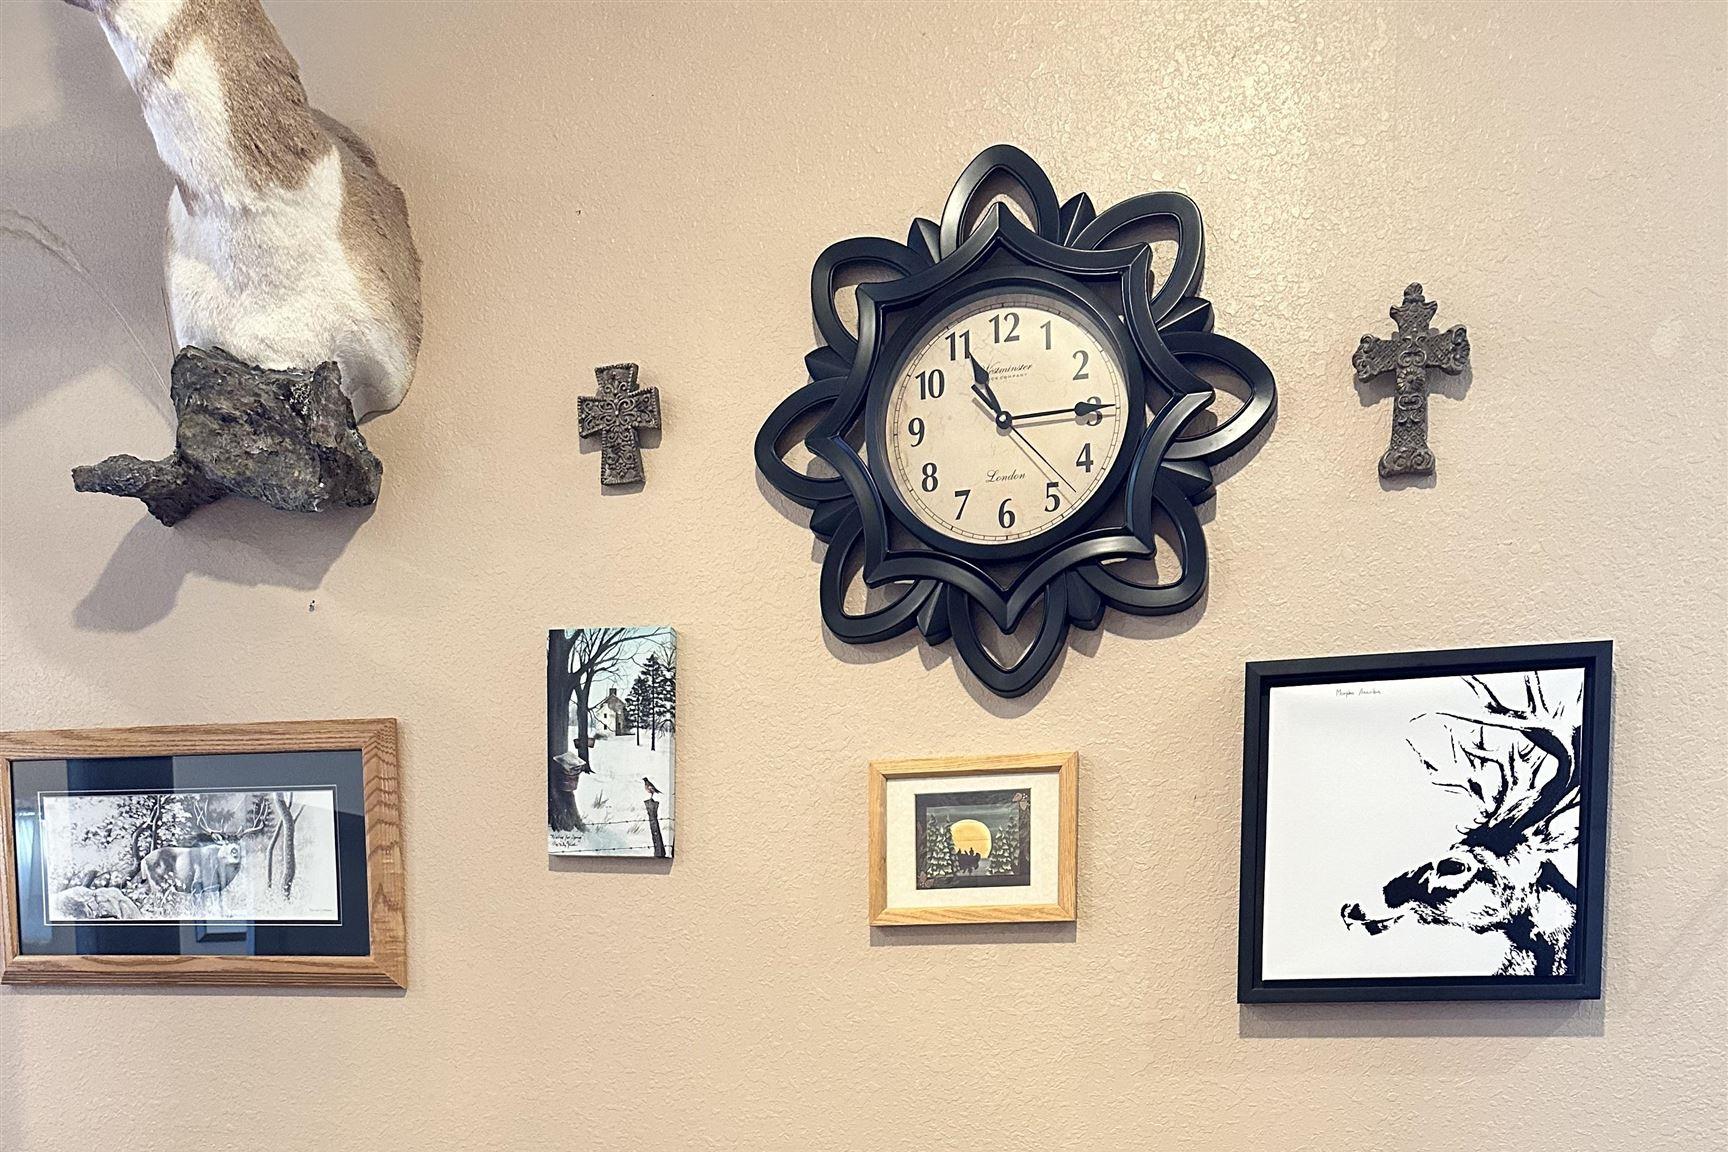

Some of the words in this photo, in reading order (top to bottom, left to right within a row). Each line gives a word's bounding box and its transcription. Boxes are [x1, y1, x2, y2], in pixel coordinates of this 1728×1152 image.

[988, 312, 1020, 343] 12
[1040, 320, 1052, 350] 1
[945, 329, 970, 361] 11
[1072, 350, 1090, 380] 2
[915, 369, 945, 400] 10
[908, 417, 925, 447] 9
[1075, 443, 1094, 473] 4
[921, 462, 939, 492] 8
[985, 469, 1026, 483] London
[954, 489, 971, 520] 7
[1044, 481, 1060, 512] 5
[998, 498, 1016, 528] 6
